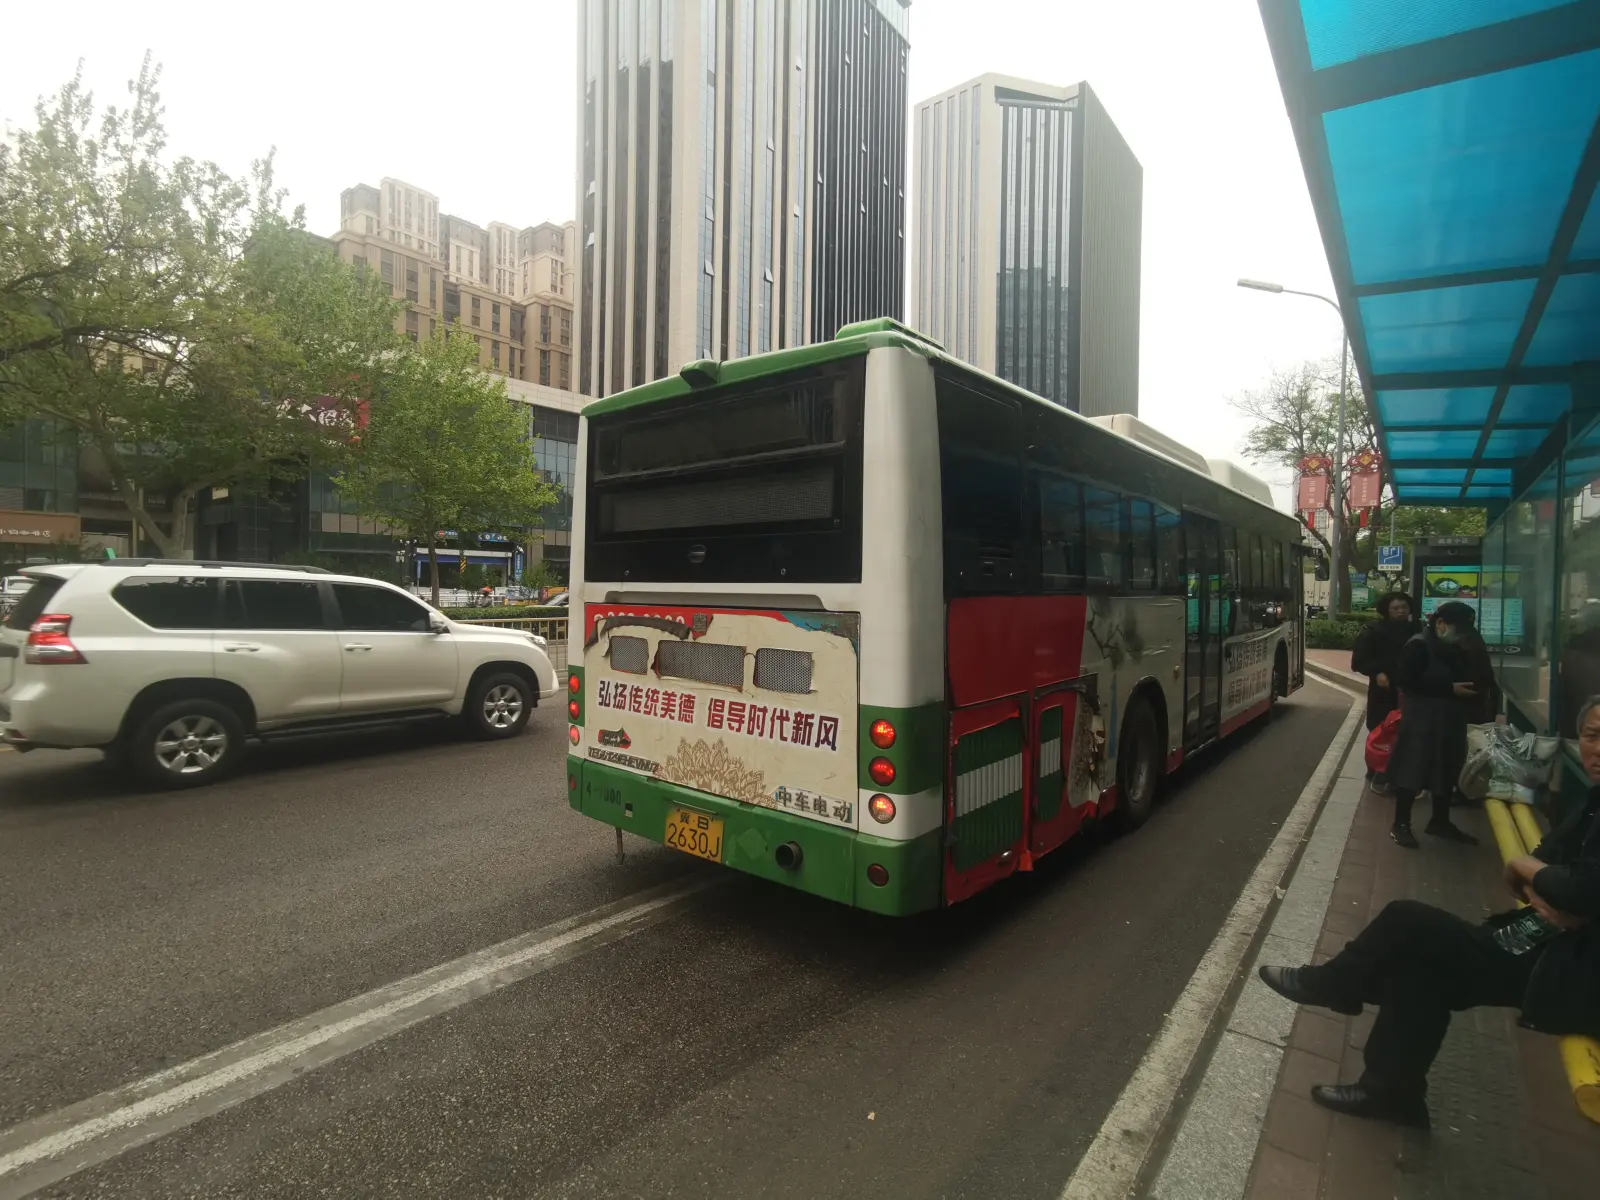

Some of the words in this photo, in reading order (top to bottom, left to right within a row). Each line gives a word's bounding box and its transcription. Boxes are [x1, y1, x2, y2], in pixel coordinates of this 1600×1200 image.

[598, 680, 696, 724] 弘扬传统美德
[707, 697, 839, 751] 倡导时代新风
[779, 787, 850, 823] 中车电动
[668, 823, 720, 858] 2630J
